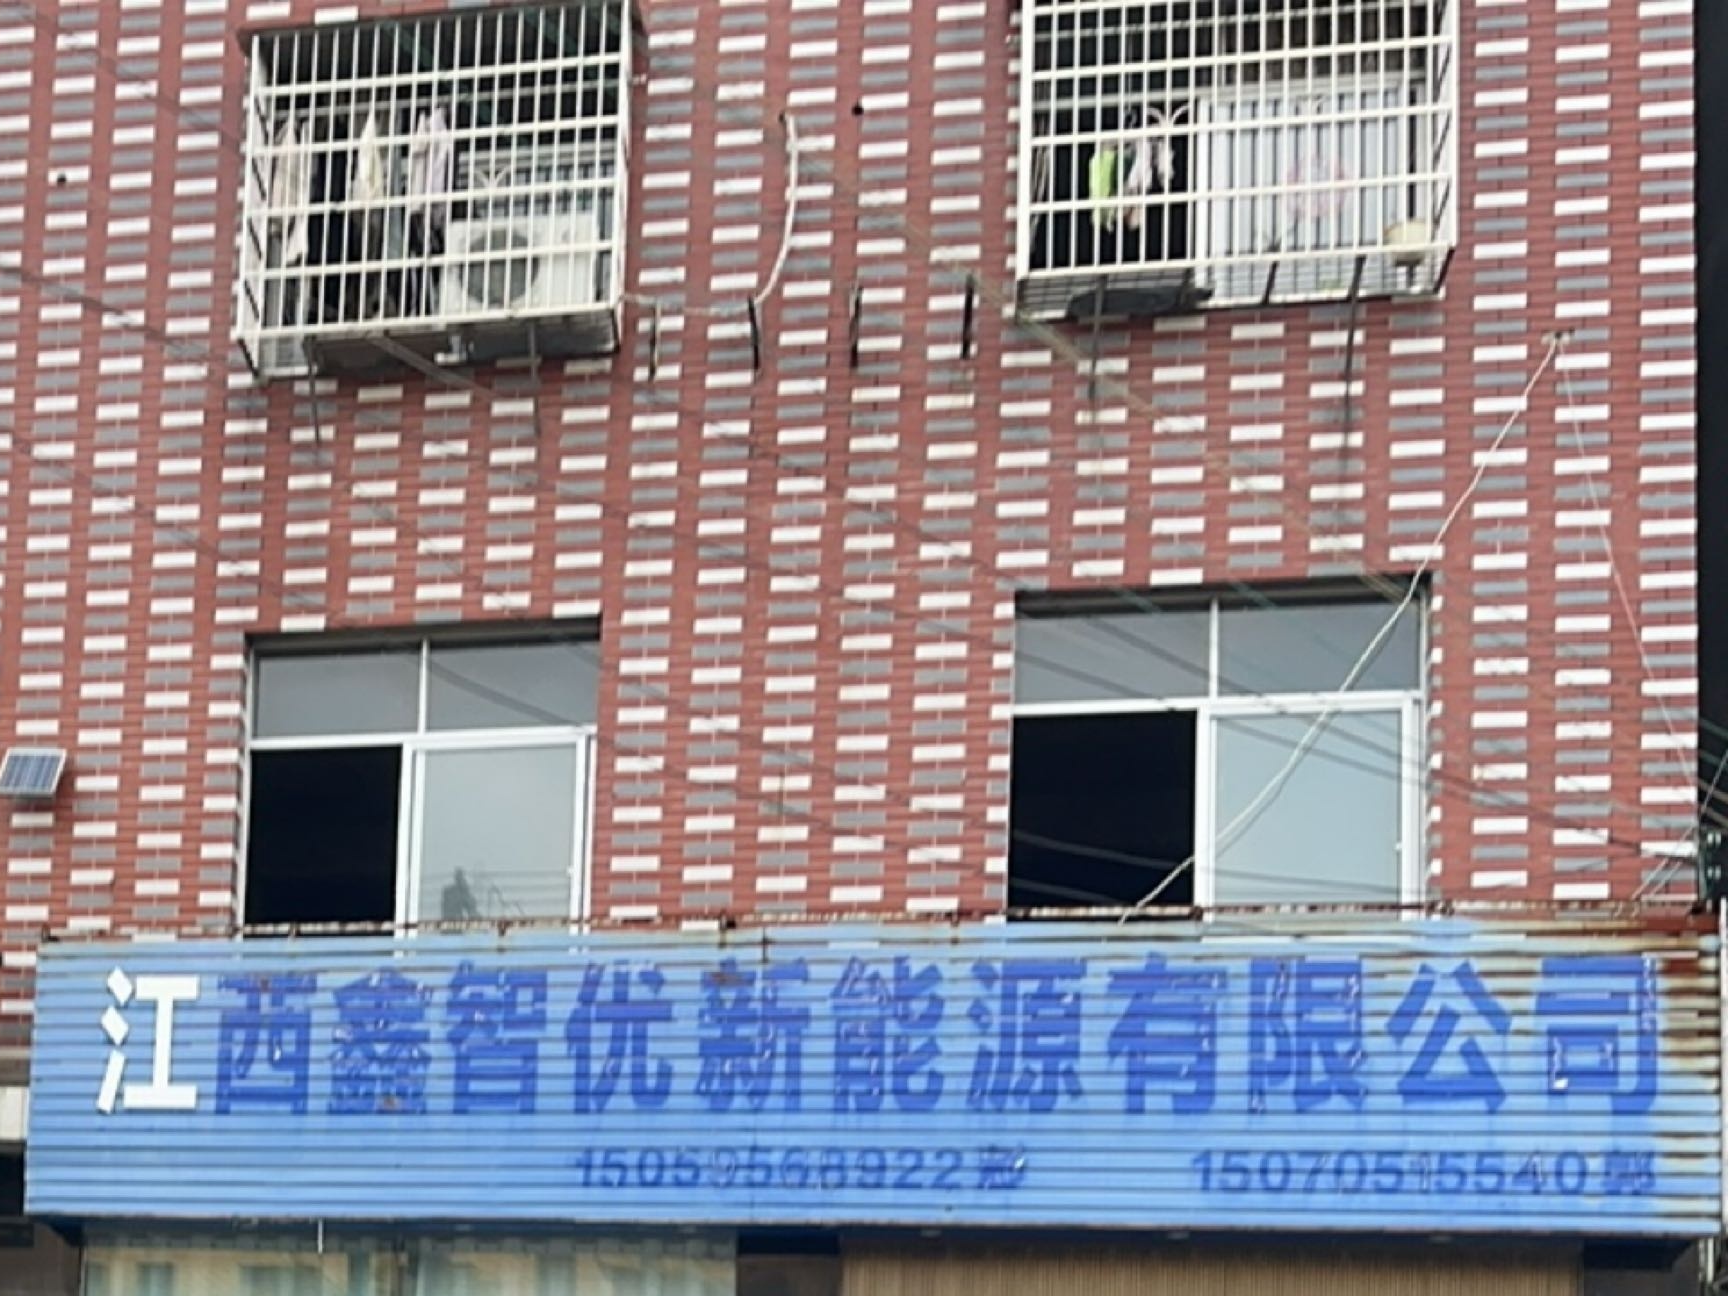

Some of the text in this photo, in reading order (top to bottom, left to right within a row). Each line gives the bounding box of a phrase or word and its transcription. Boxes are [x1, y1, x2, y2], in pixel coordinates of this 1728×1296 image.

[96, 954, 1658, 1115] 江西鑫智优新能源有限公司
